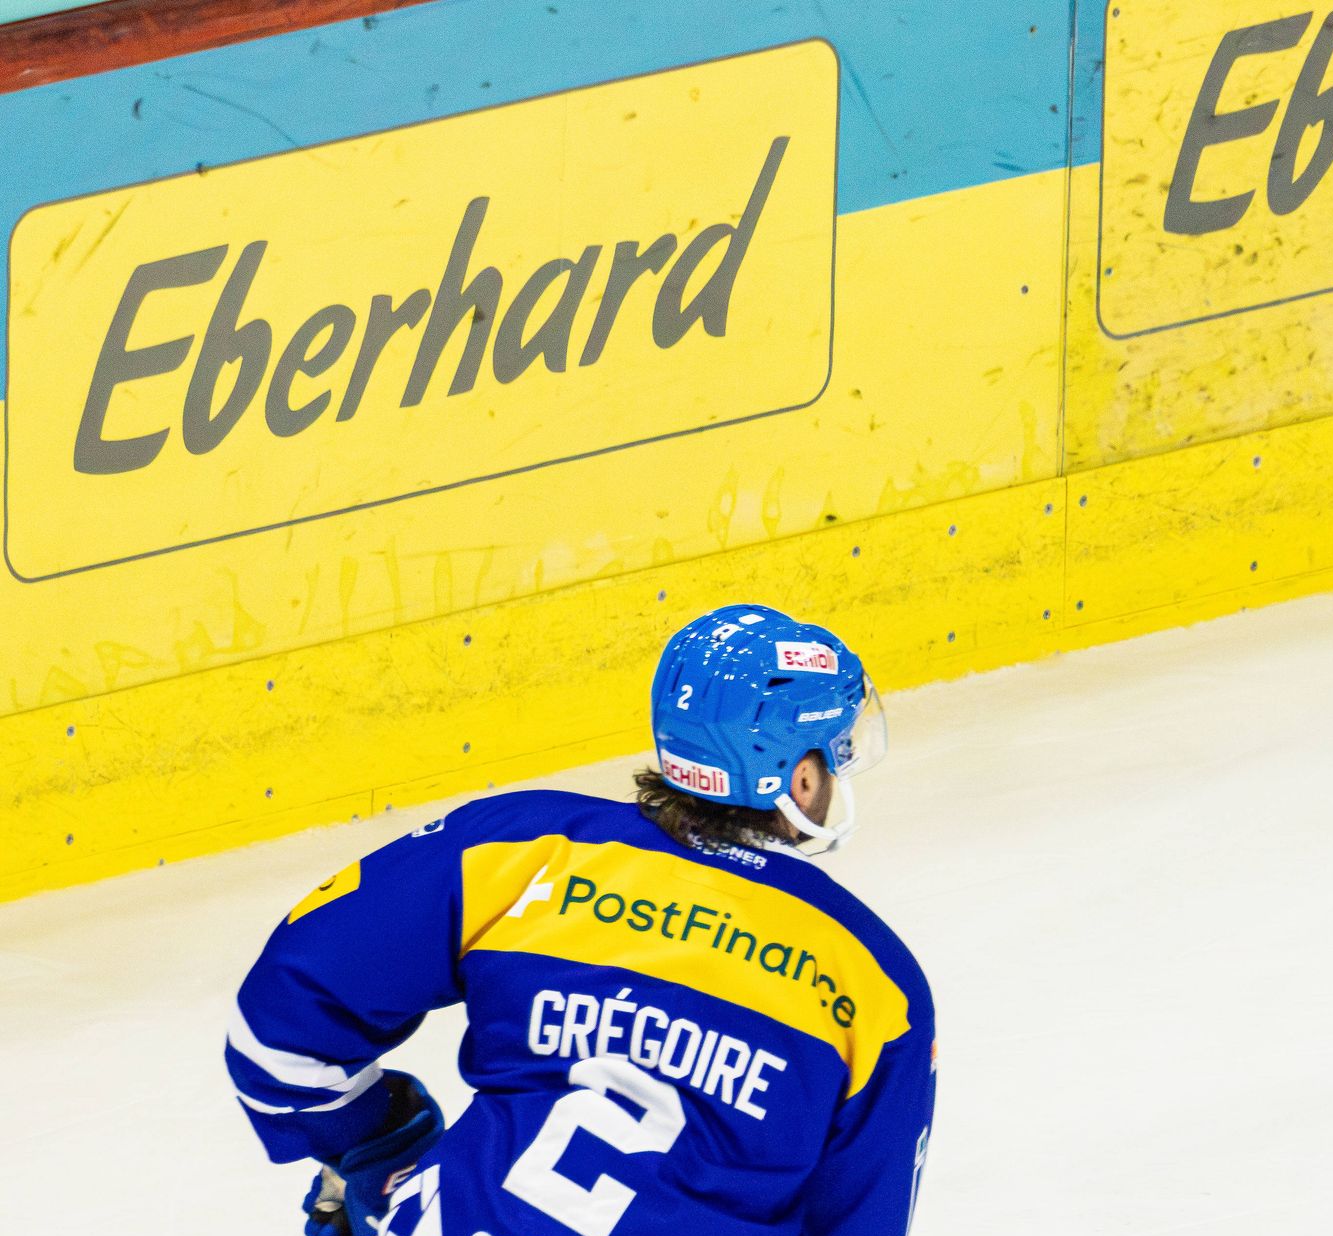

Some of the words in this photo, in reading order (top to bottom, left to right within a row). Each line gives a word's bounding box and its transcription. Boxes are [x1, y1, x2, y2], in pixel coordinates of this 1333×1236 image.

[73, 136, 790, 475] Eberhard
[677, 685, 693, 710] 2
[558, 875, 857, 1029] PostFinance
[528, 988, 788, 1121] GRÉGOIRE
